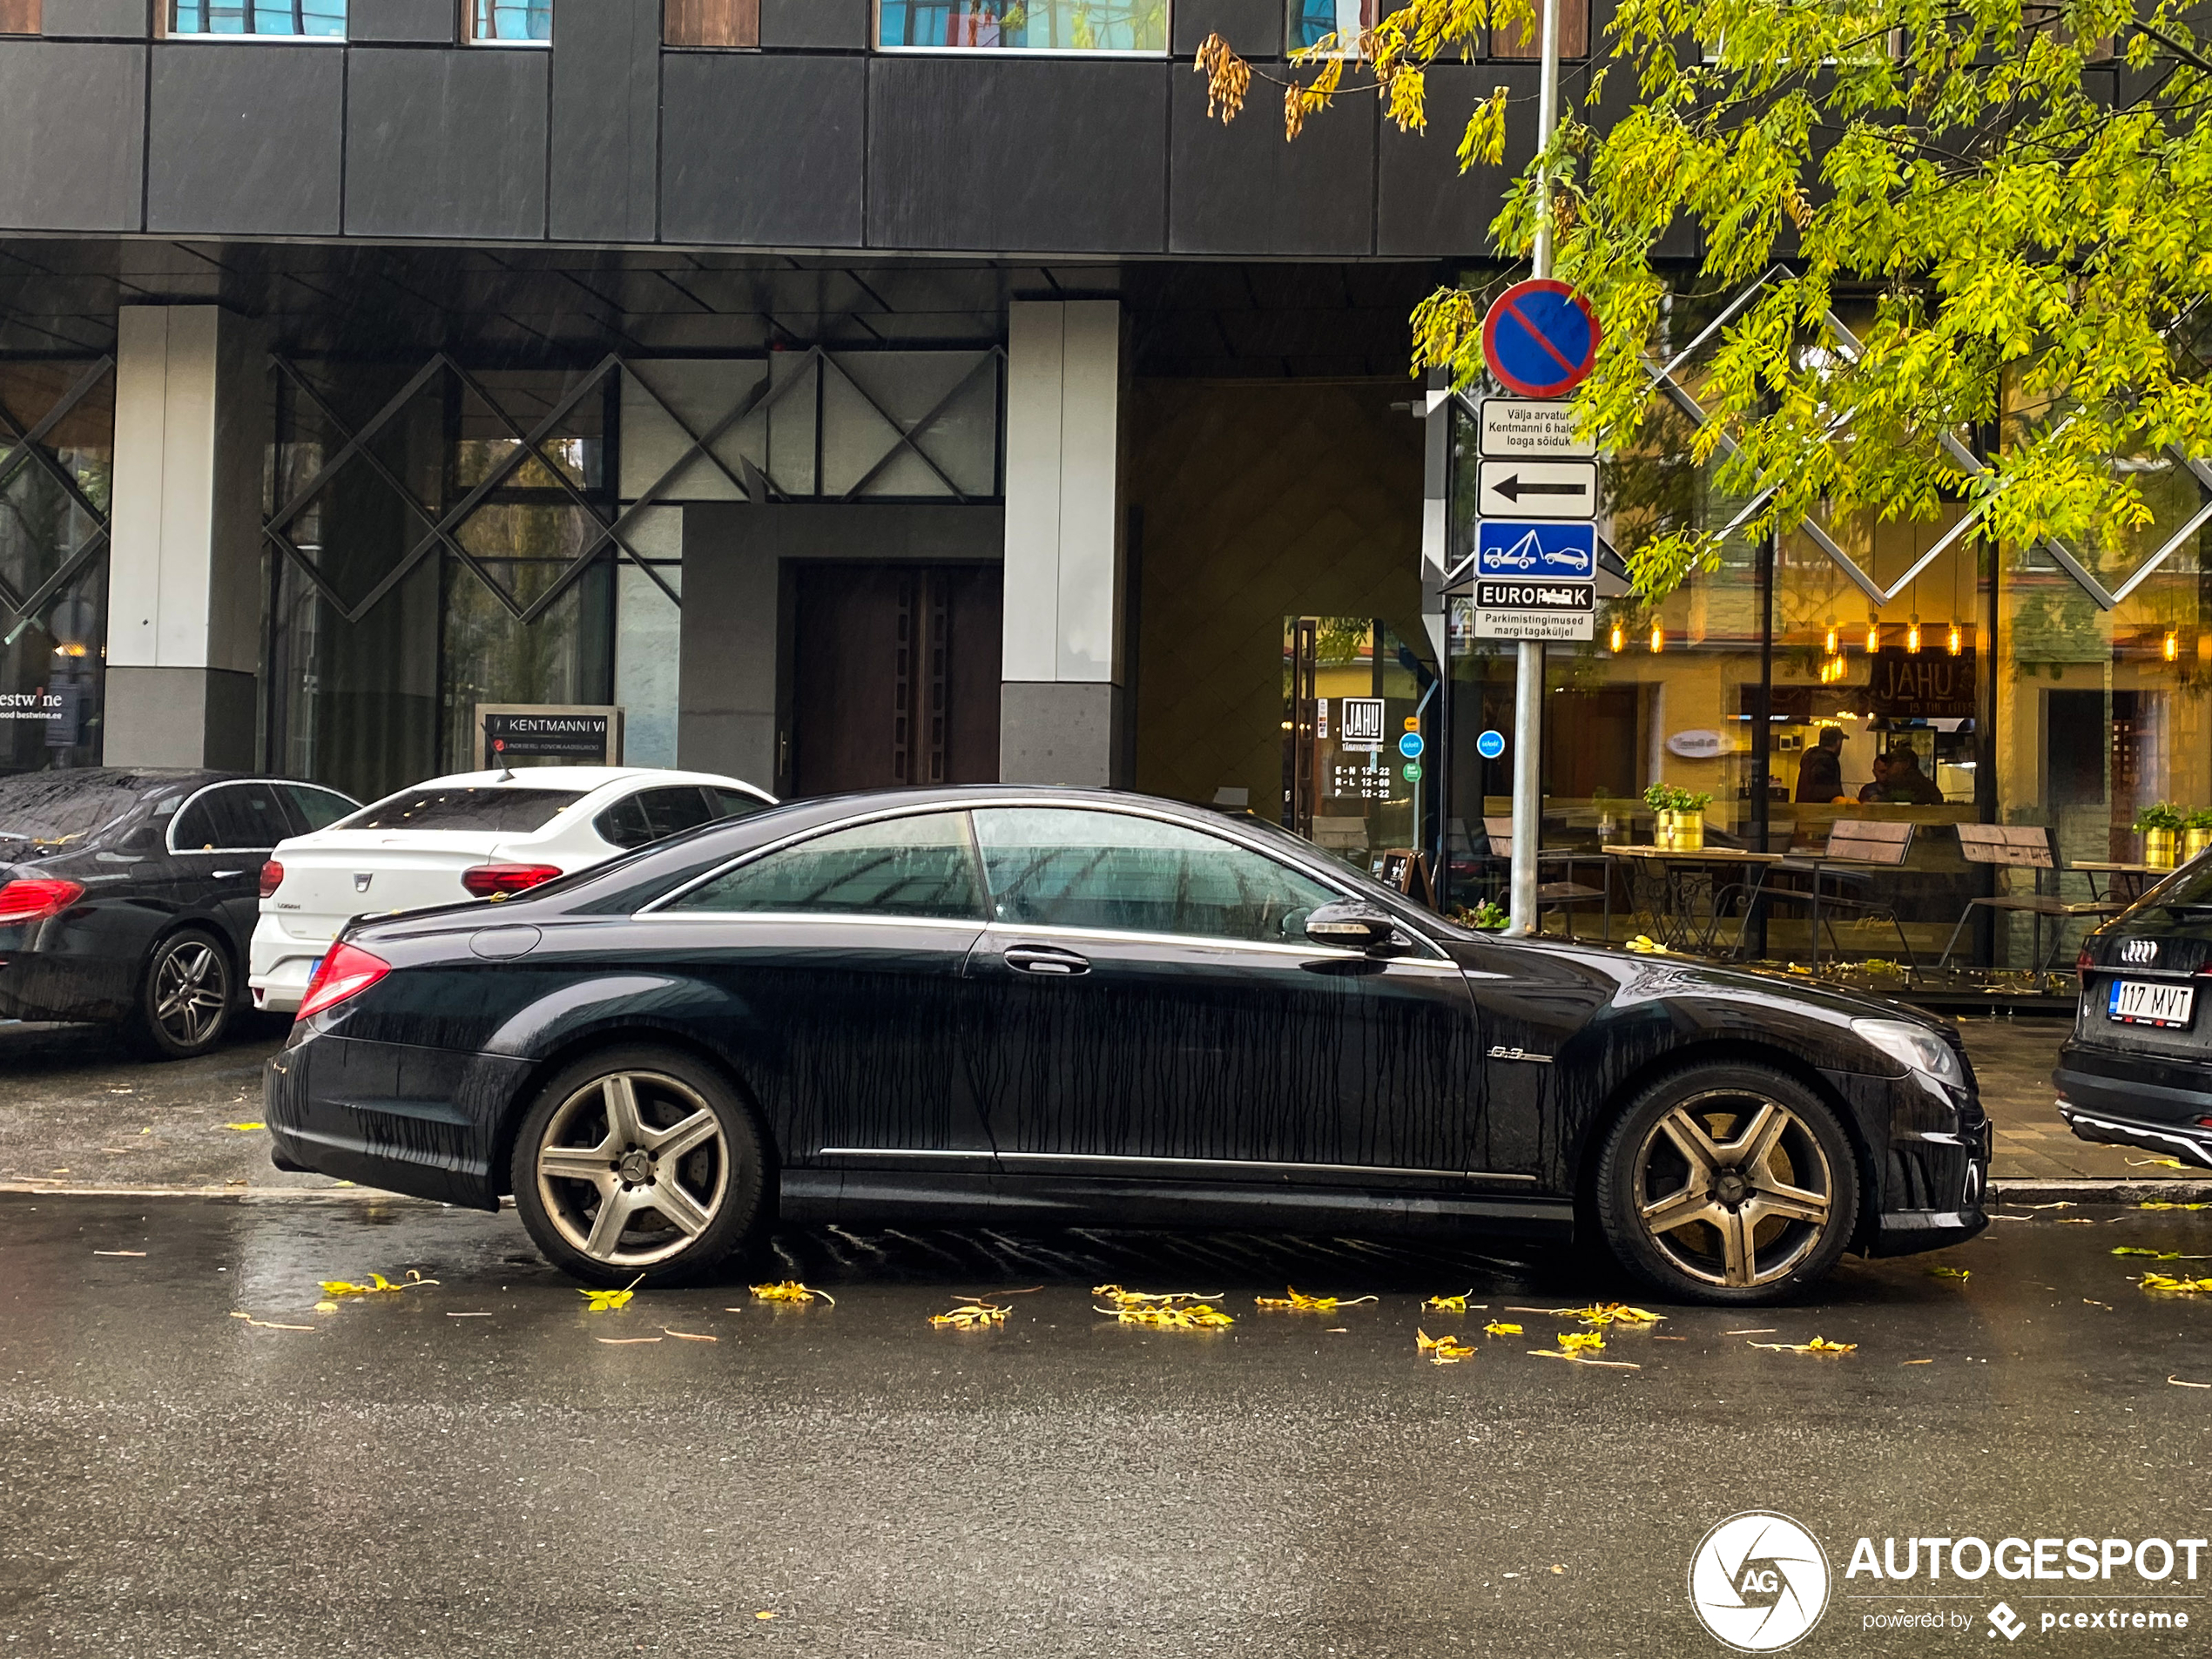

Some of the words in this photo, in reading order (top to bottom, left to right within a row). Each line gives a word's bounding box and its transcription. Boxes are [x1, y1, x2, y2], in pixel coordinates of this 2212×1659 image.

[1507, 409, 1531, 421] Välja
[1489, 421, 1542, 433] Kentmanni
[1545, 423, 1551, 433] 6
[1554, 423, 1575, 433] hald
[1507, 435, 1534, 448] loaga
[1537, 436, 1571, 446] sõiduk
[1485, 613, 1584, 625] Parkimistingimused
[1494, 627, 1522, 637] margi
[1525, 627, 1573, 638] tagaküljel
[1880, 661, 1954, 700] JAHU
[17, 711, 62, 719] bestwine.ee
[1346, 704, 1379, 736] JAHU
[509, 719, 590, 732] KENTMANNI
[593, 721, 604, 732] VI
[2121, 984, 2146, 1012] 117
[2151, 987, 2188, 1017] MVT
